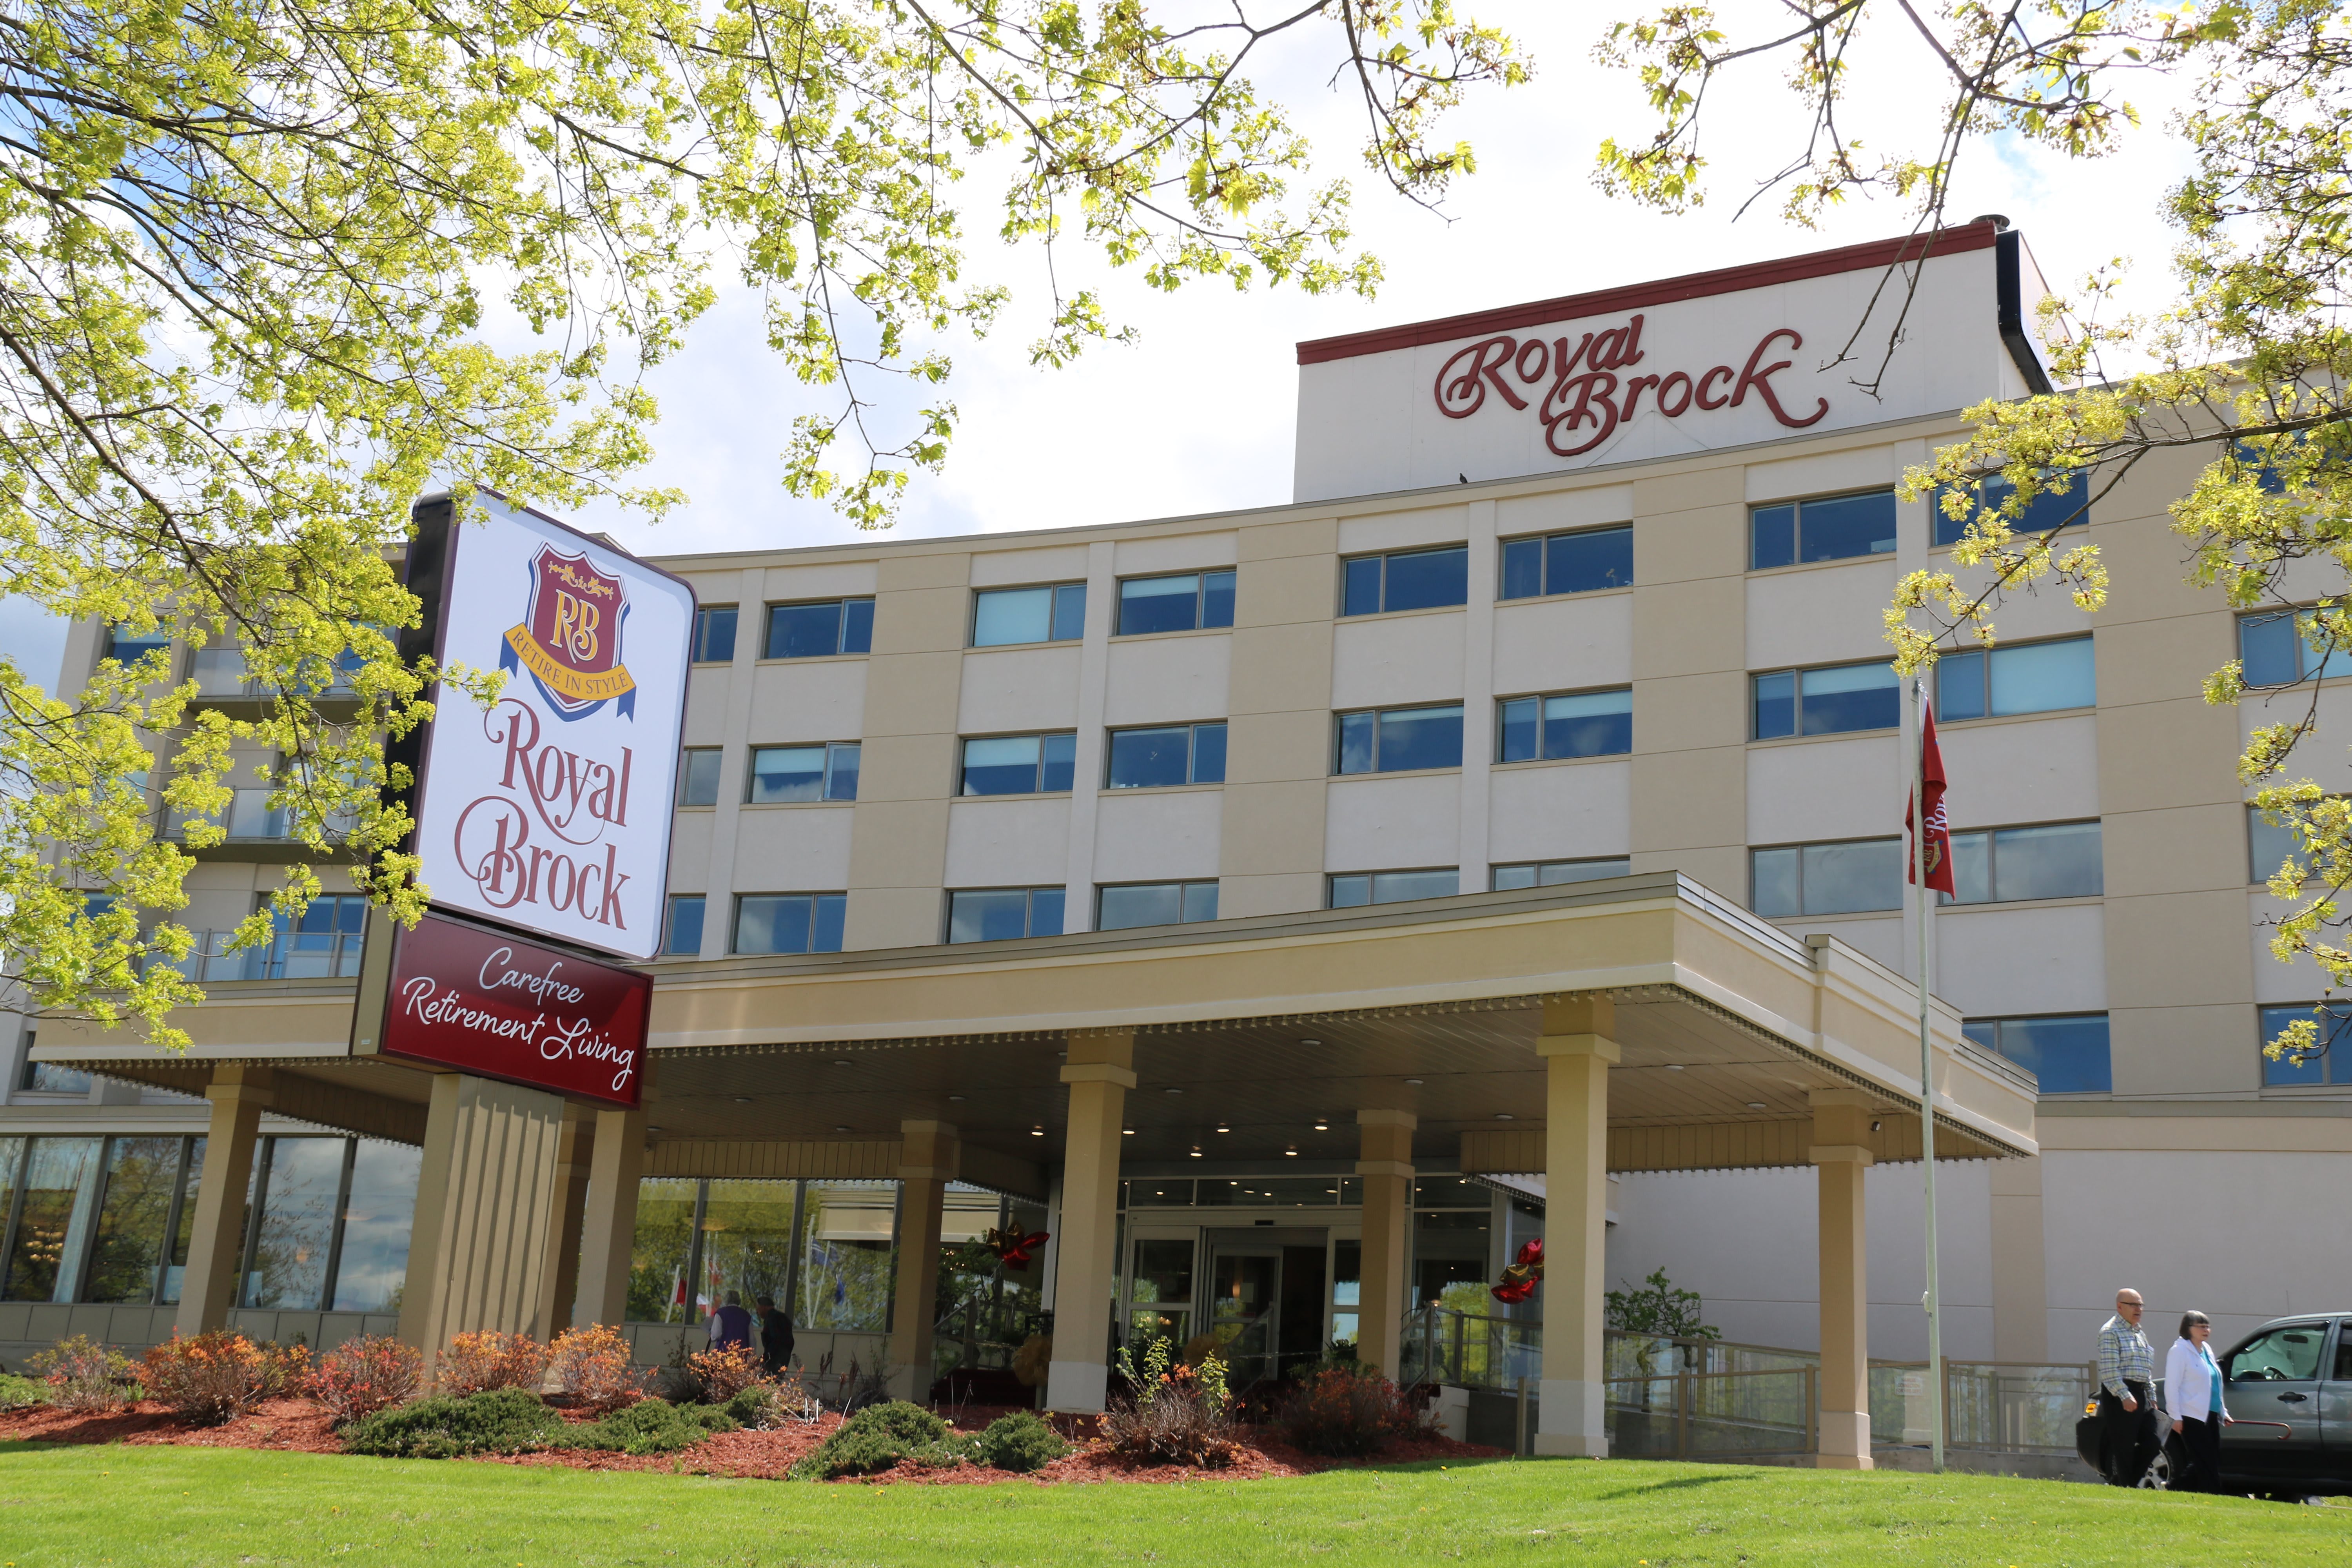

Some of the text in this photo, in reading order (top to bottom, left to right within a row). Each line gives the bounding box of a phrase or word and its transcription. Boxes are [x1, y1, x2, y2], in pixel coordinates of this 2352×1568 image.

[1435, 314, 1644, 425] Royal
[1545, 328, 1828, 457] Brock
[512, 631, 628, 695] RETIRE IN STYLE
[550, 589, 599, 663] RB
[484, 698, 632, 845] Royal
[454, 796, 631, 930] Brock
[479, 947, 584, 1006] Carefree
[403, 976, 635, 1091] Retirement Living
